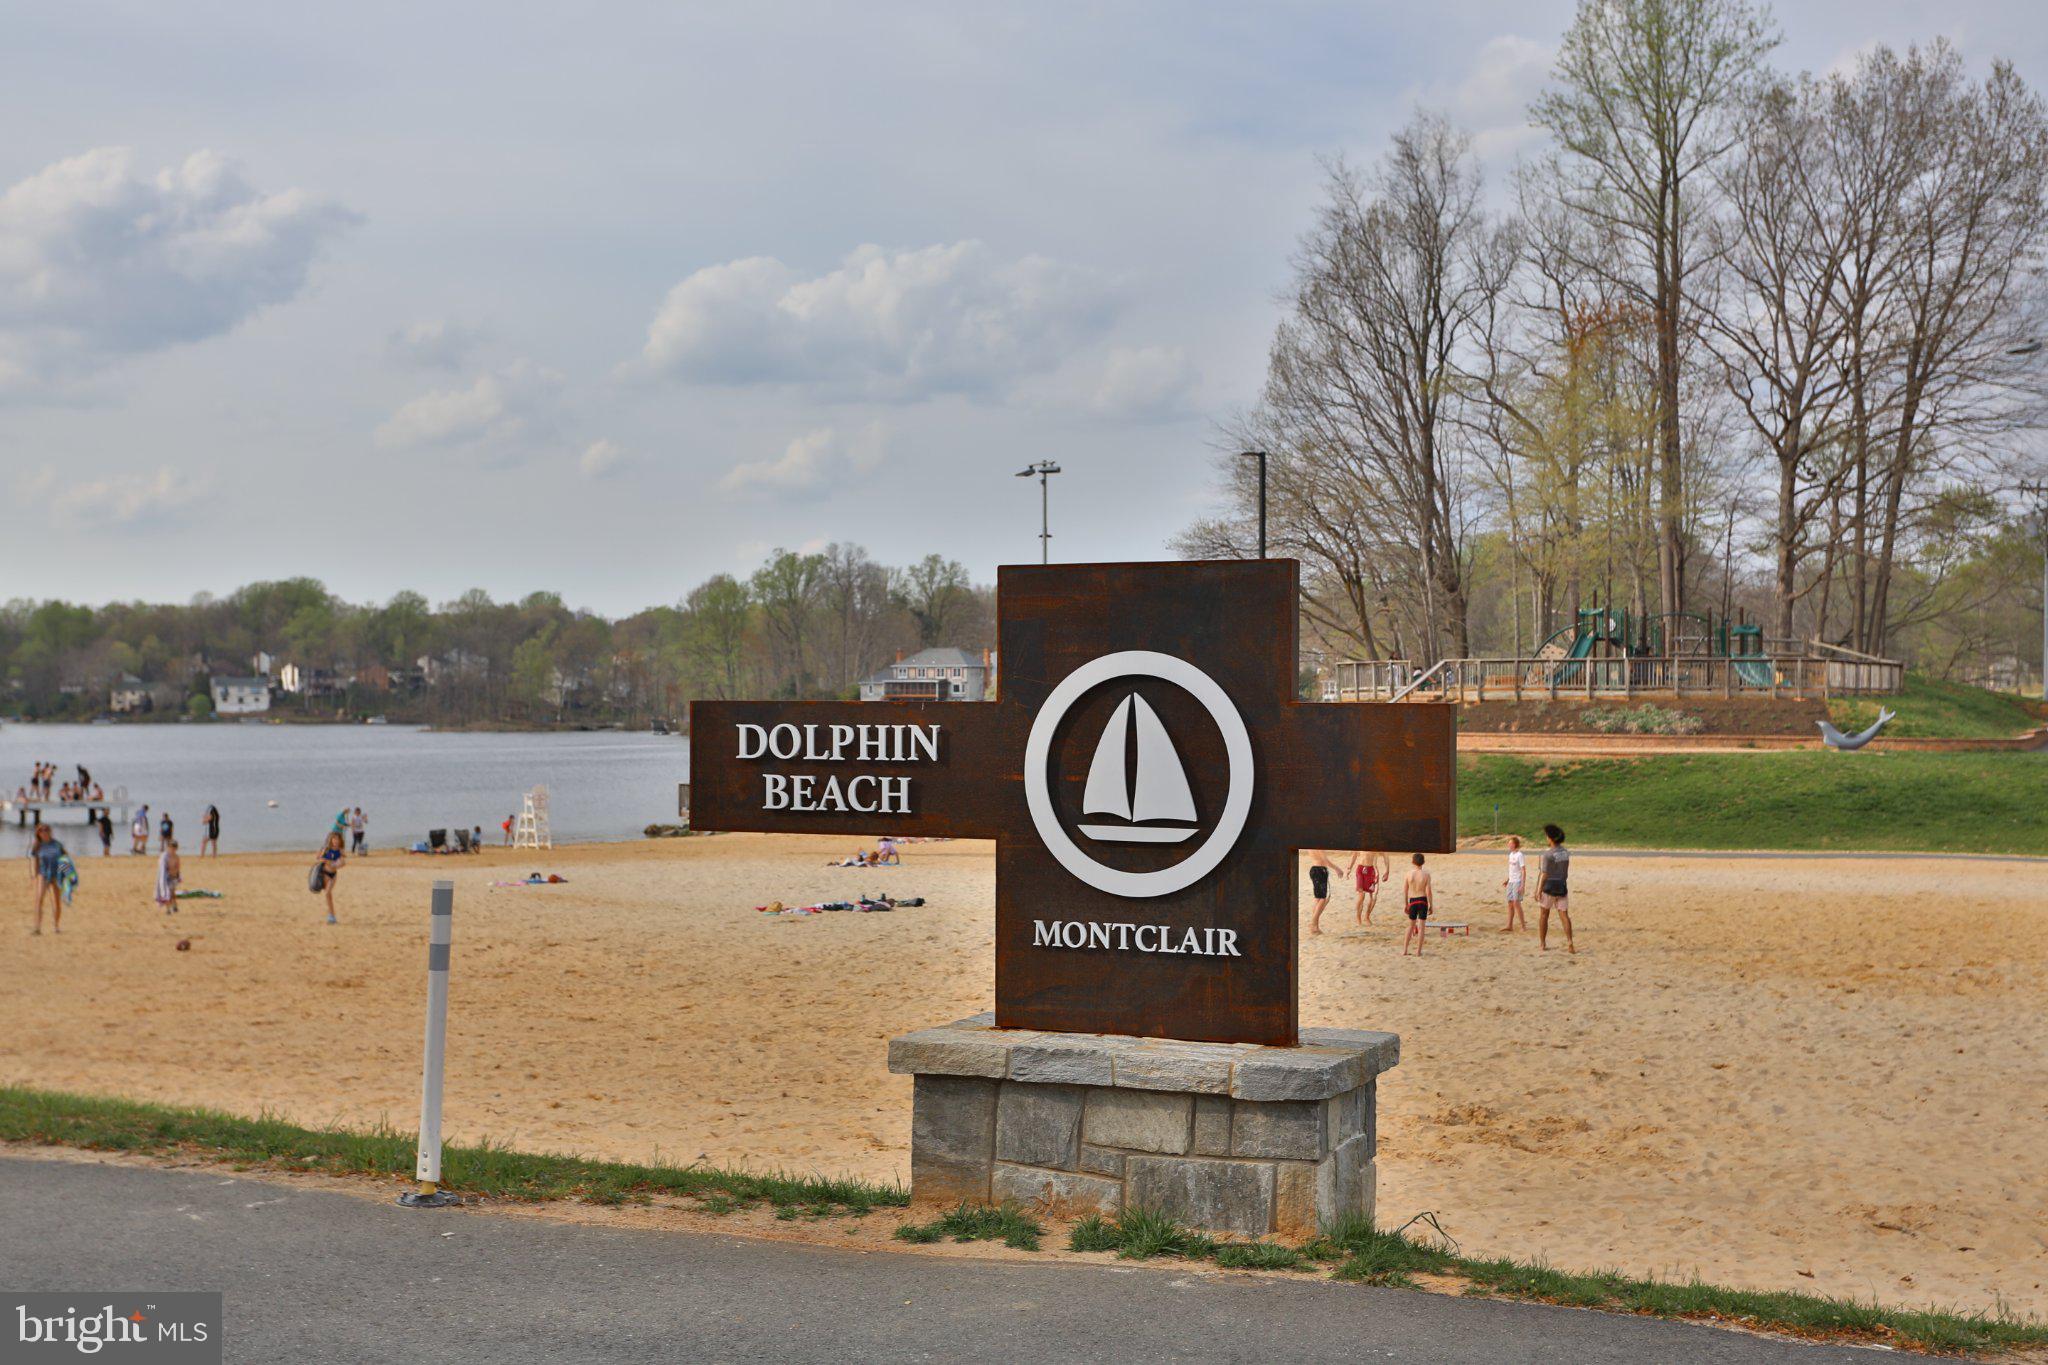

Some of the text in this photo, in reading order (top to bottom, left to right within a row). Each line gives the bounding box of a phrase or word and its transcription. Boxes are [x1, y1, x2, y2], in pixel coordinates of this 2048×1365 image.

[736, 723, 941, 762] DOLPHIN
[762, 773, 912, 814] BEACH
[1032, 919, 1242, 957] MONTCLAIR
